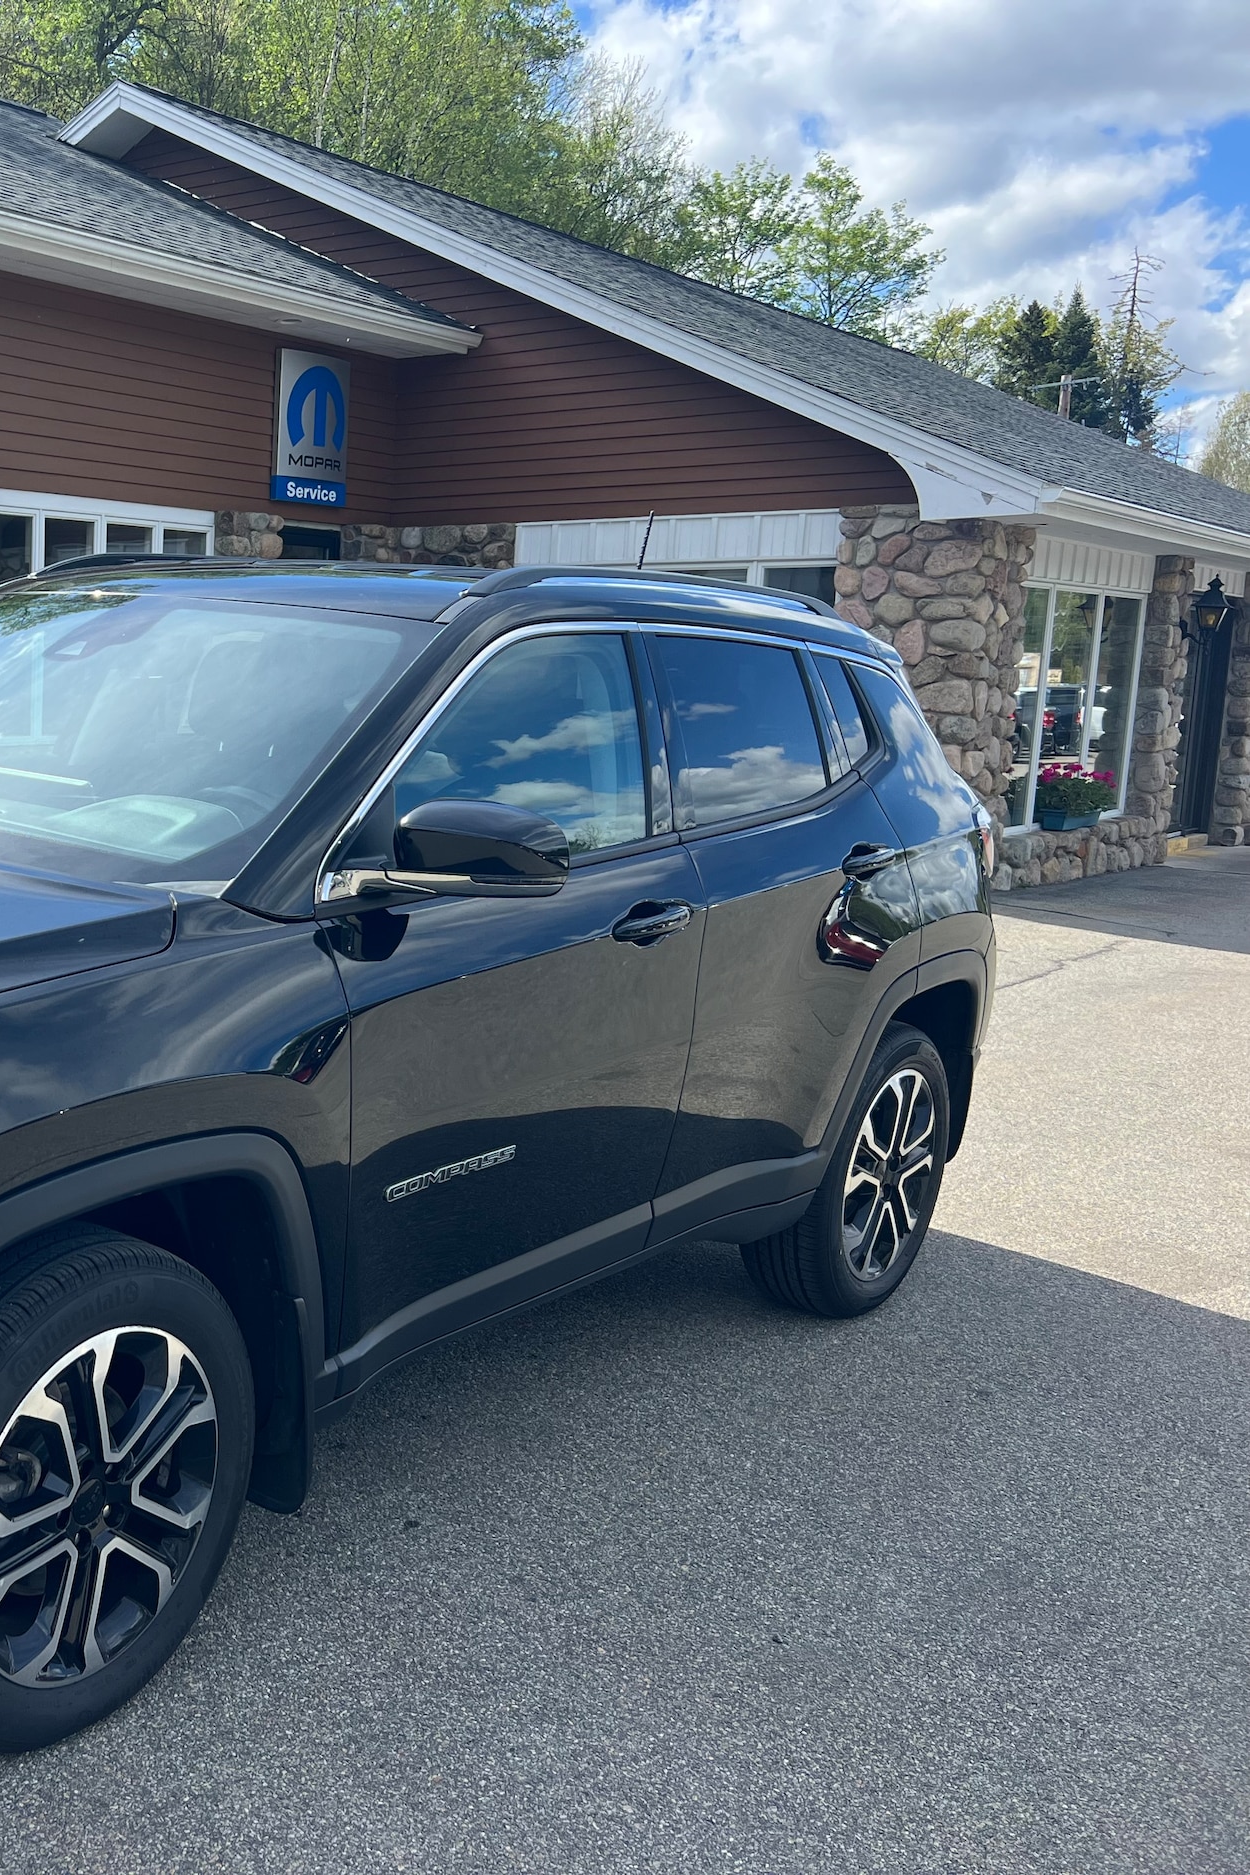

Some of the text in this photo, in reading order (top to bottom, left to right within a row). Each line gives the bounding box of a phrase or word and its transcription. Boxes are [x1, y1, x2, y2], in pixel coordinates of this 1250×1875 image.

[288, 453, 341, 472] MOPAR
[286, 481, 337, 502] Service
[385, 1144, 517, 1203] COMPASS
